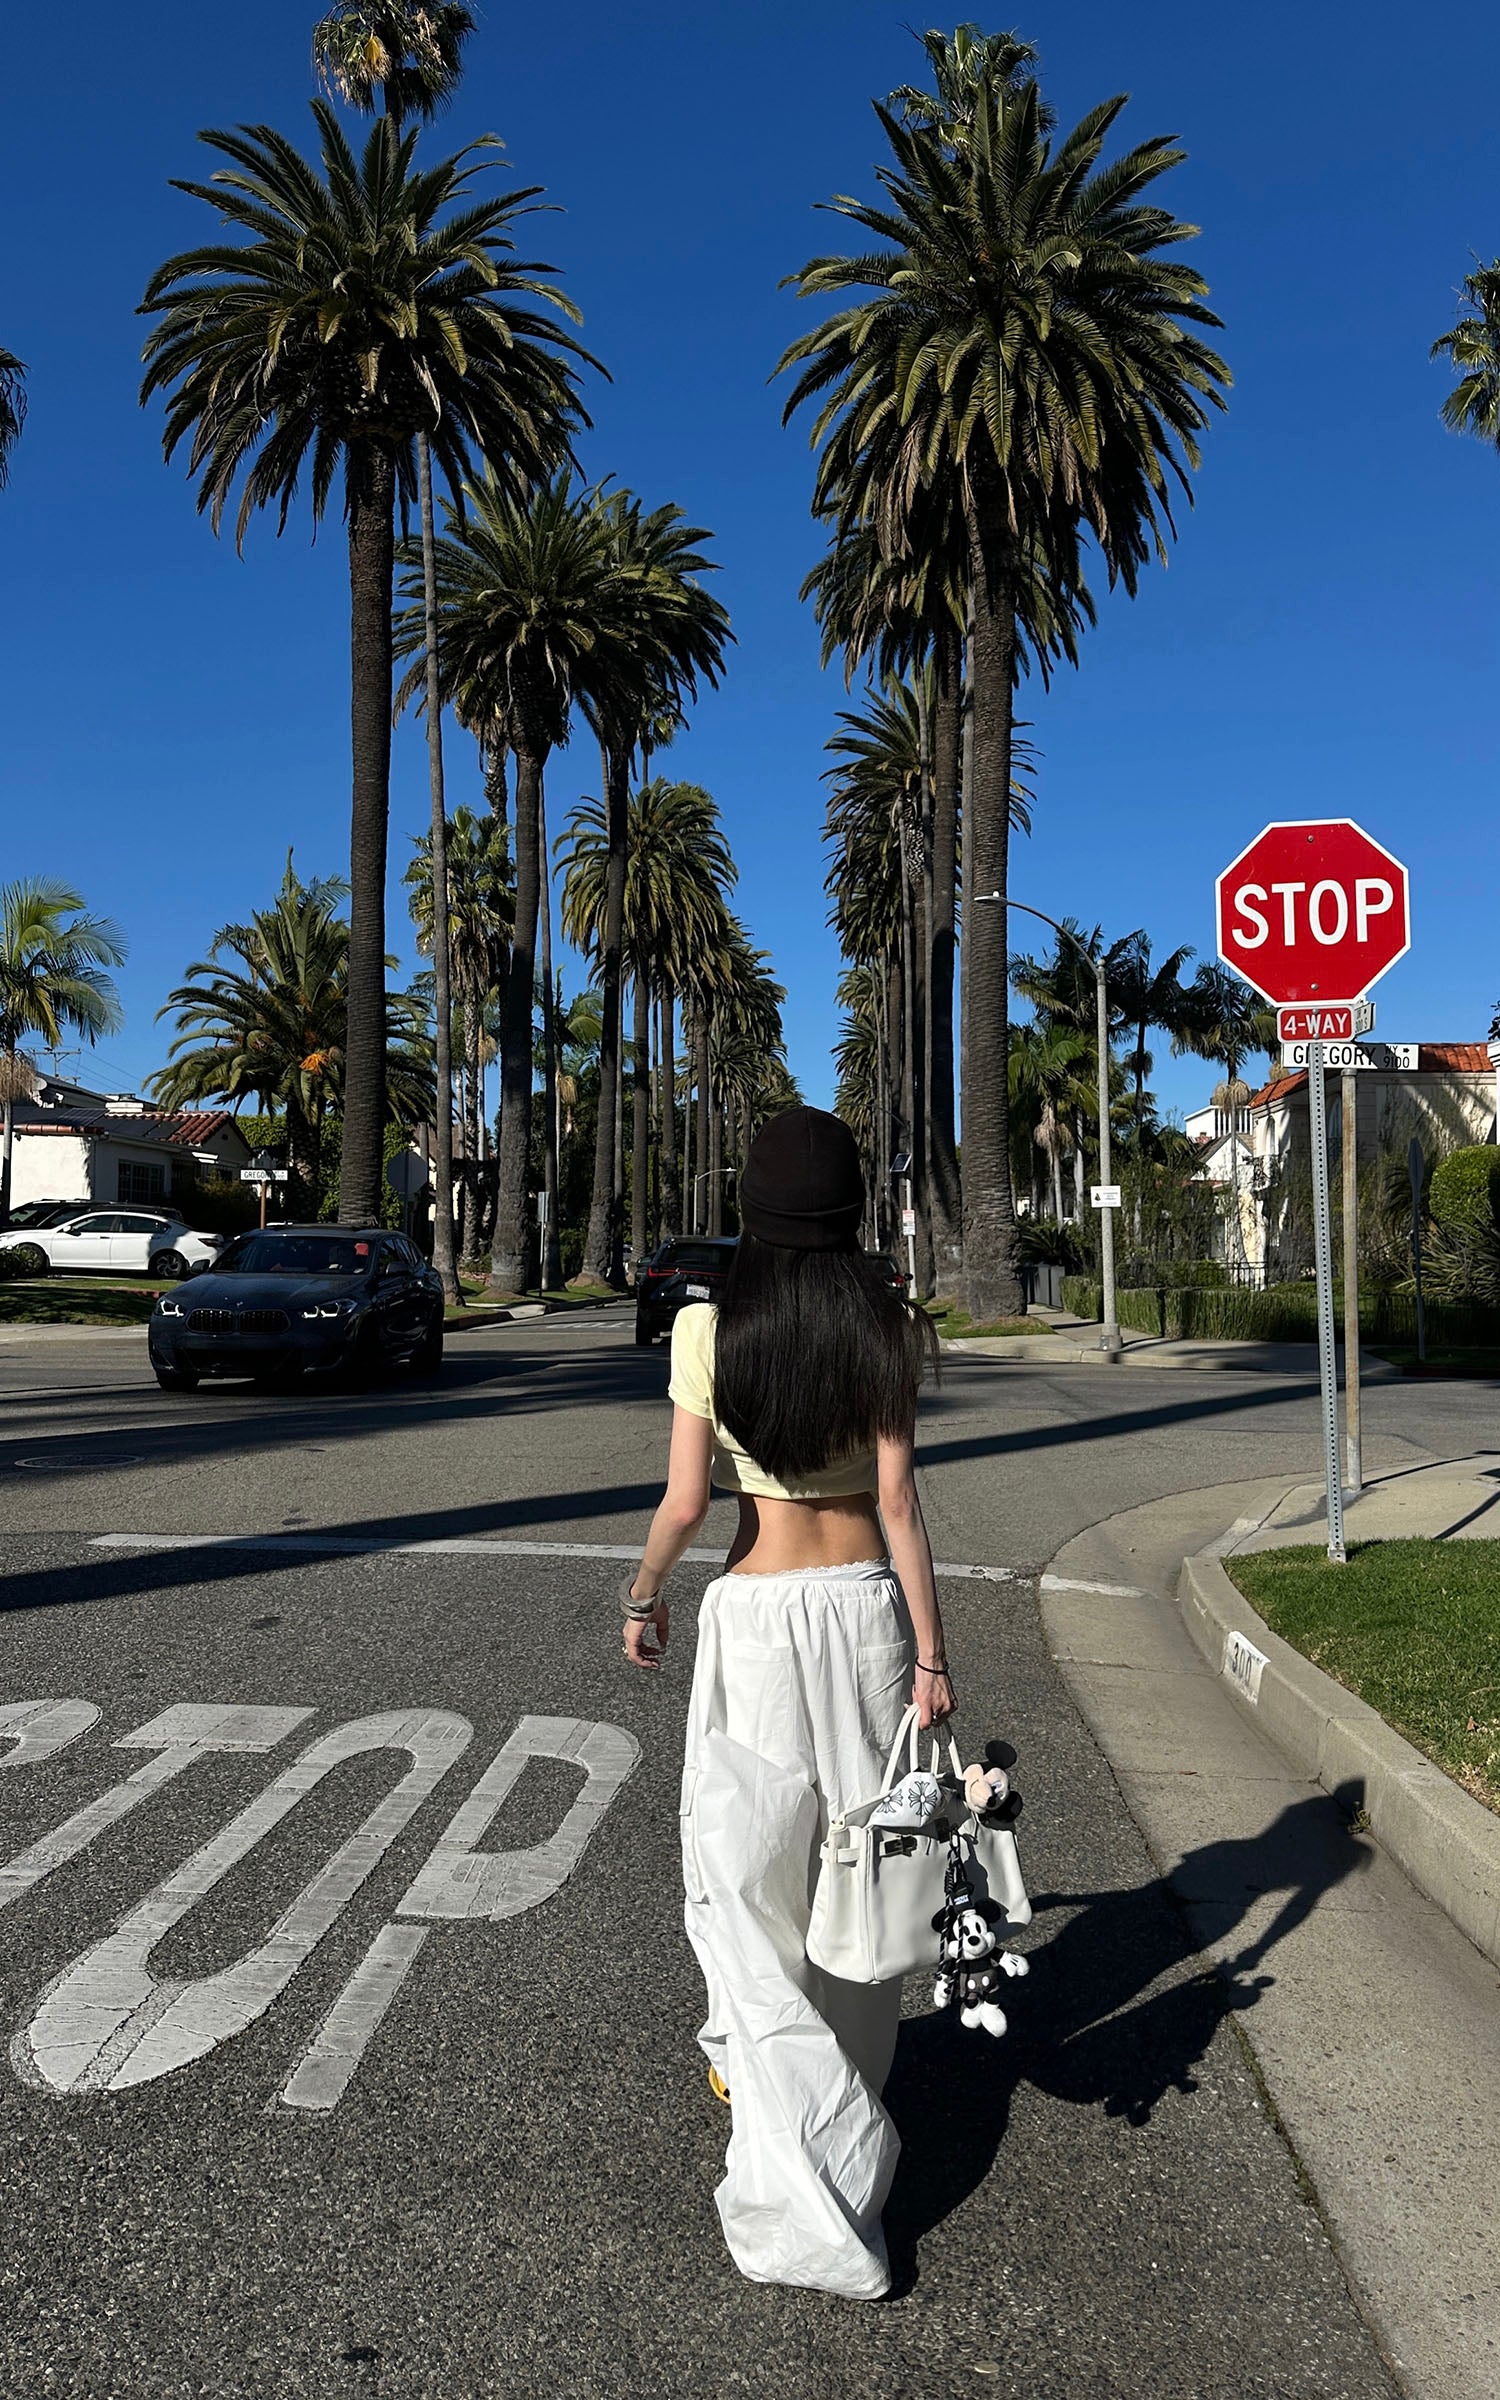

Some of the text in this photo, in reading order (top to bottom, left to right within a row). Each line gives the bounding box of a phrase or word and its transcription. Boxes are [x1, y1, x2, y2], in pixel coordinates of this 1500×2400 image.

[1231, 877, 1394, 949] STOP
[1283, 1012, 1348, 1035] 4-WAY
[1383, 1055, 1410, 1069] 9100
[0, 1697, 642, 2114] TOP
